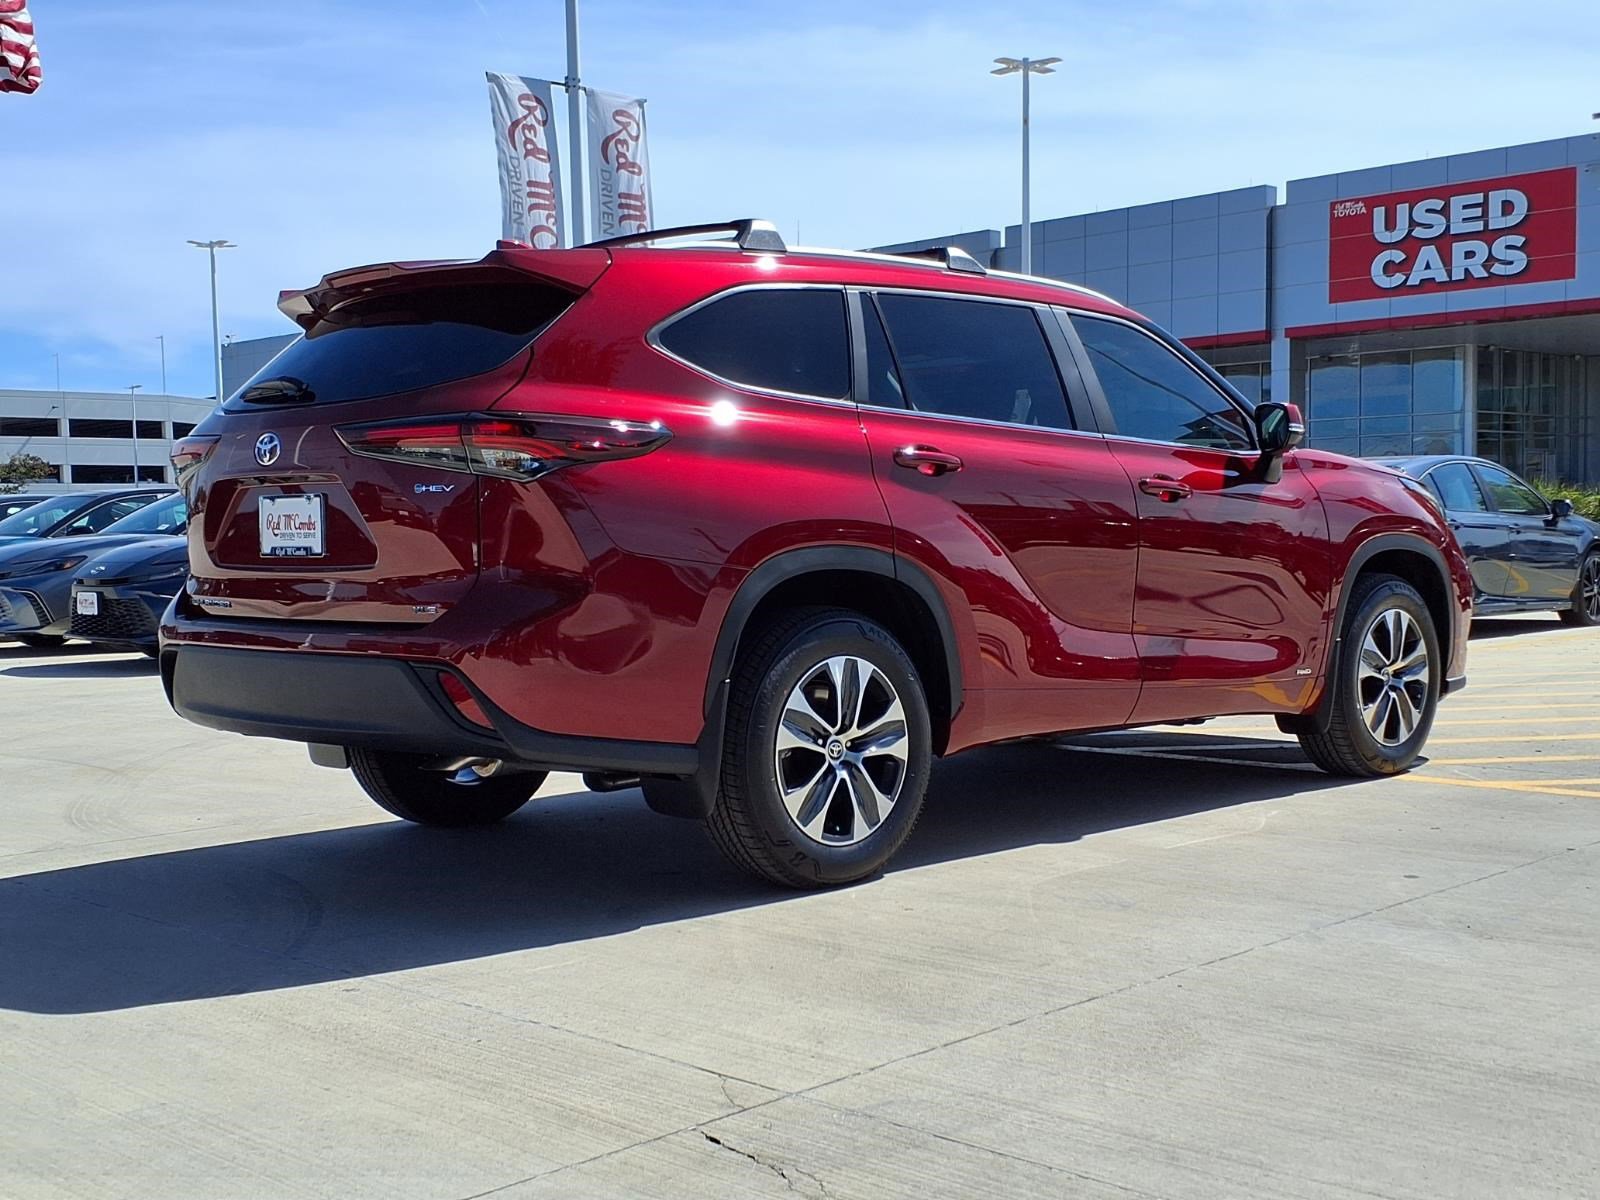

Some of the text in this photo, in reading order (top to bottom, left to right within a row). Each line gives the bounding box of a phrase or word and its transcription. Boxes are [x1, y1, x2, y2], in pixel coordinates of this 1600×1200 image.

[508, 93, 551, 164] Red
[601, 109, 643, 177] Red
[510, 155, 525, 226] DRIVEN
[600, 168, 616, 236] DRIVEN
[1333, 206, 1367, 218] TOYOTA
[1372, 188, 1529, 244] USED
[1370, 234, 1529, 289] CARS
[266, 512, 316, 537] Red McCombs
